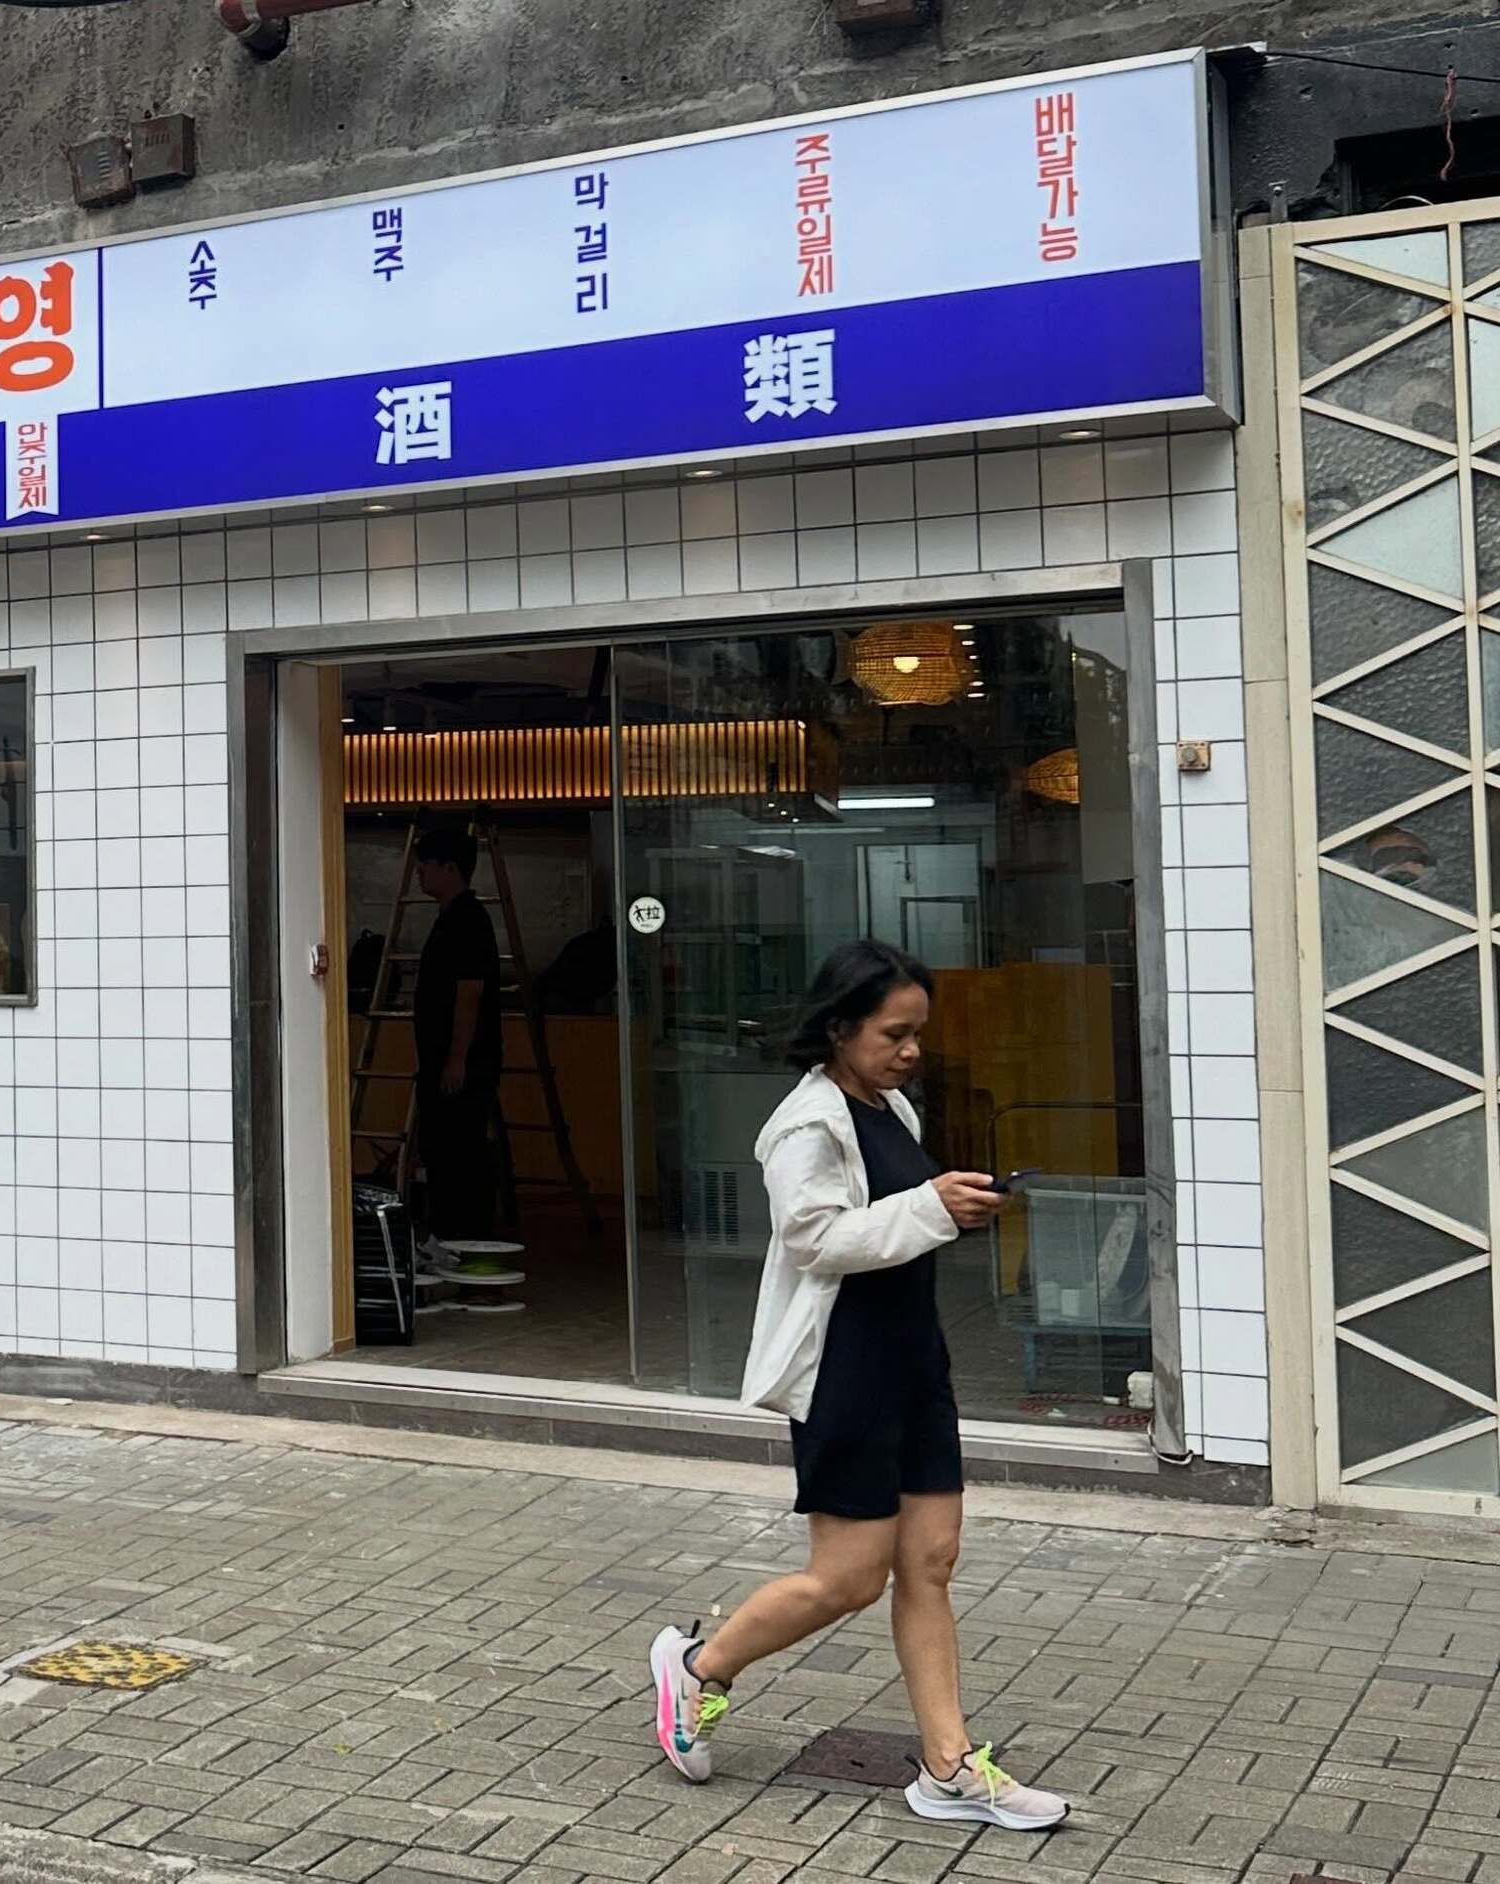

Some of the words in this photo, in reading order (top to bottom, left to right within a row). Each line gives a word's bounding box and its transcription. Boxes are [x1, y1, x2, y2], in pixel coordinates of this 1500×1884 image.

[796, 133, 833, 297] 주류일제
[1036, 93, 1078, 262] 배달가능
[189, 240, 217, 310] 소주
[372, 207, 404, 282] 맥주
[574, 173, 609, 314] 막걸리
[18, 423, 47, 509] 안주일제
[645, 905, 660, 920] 拉
